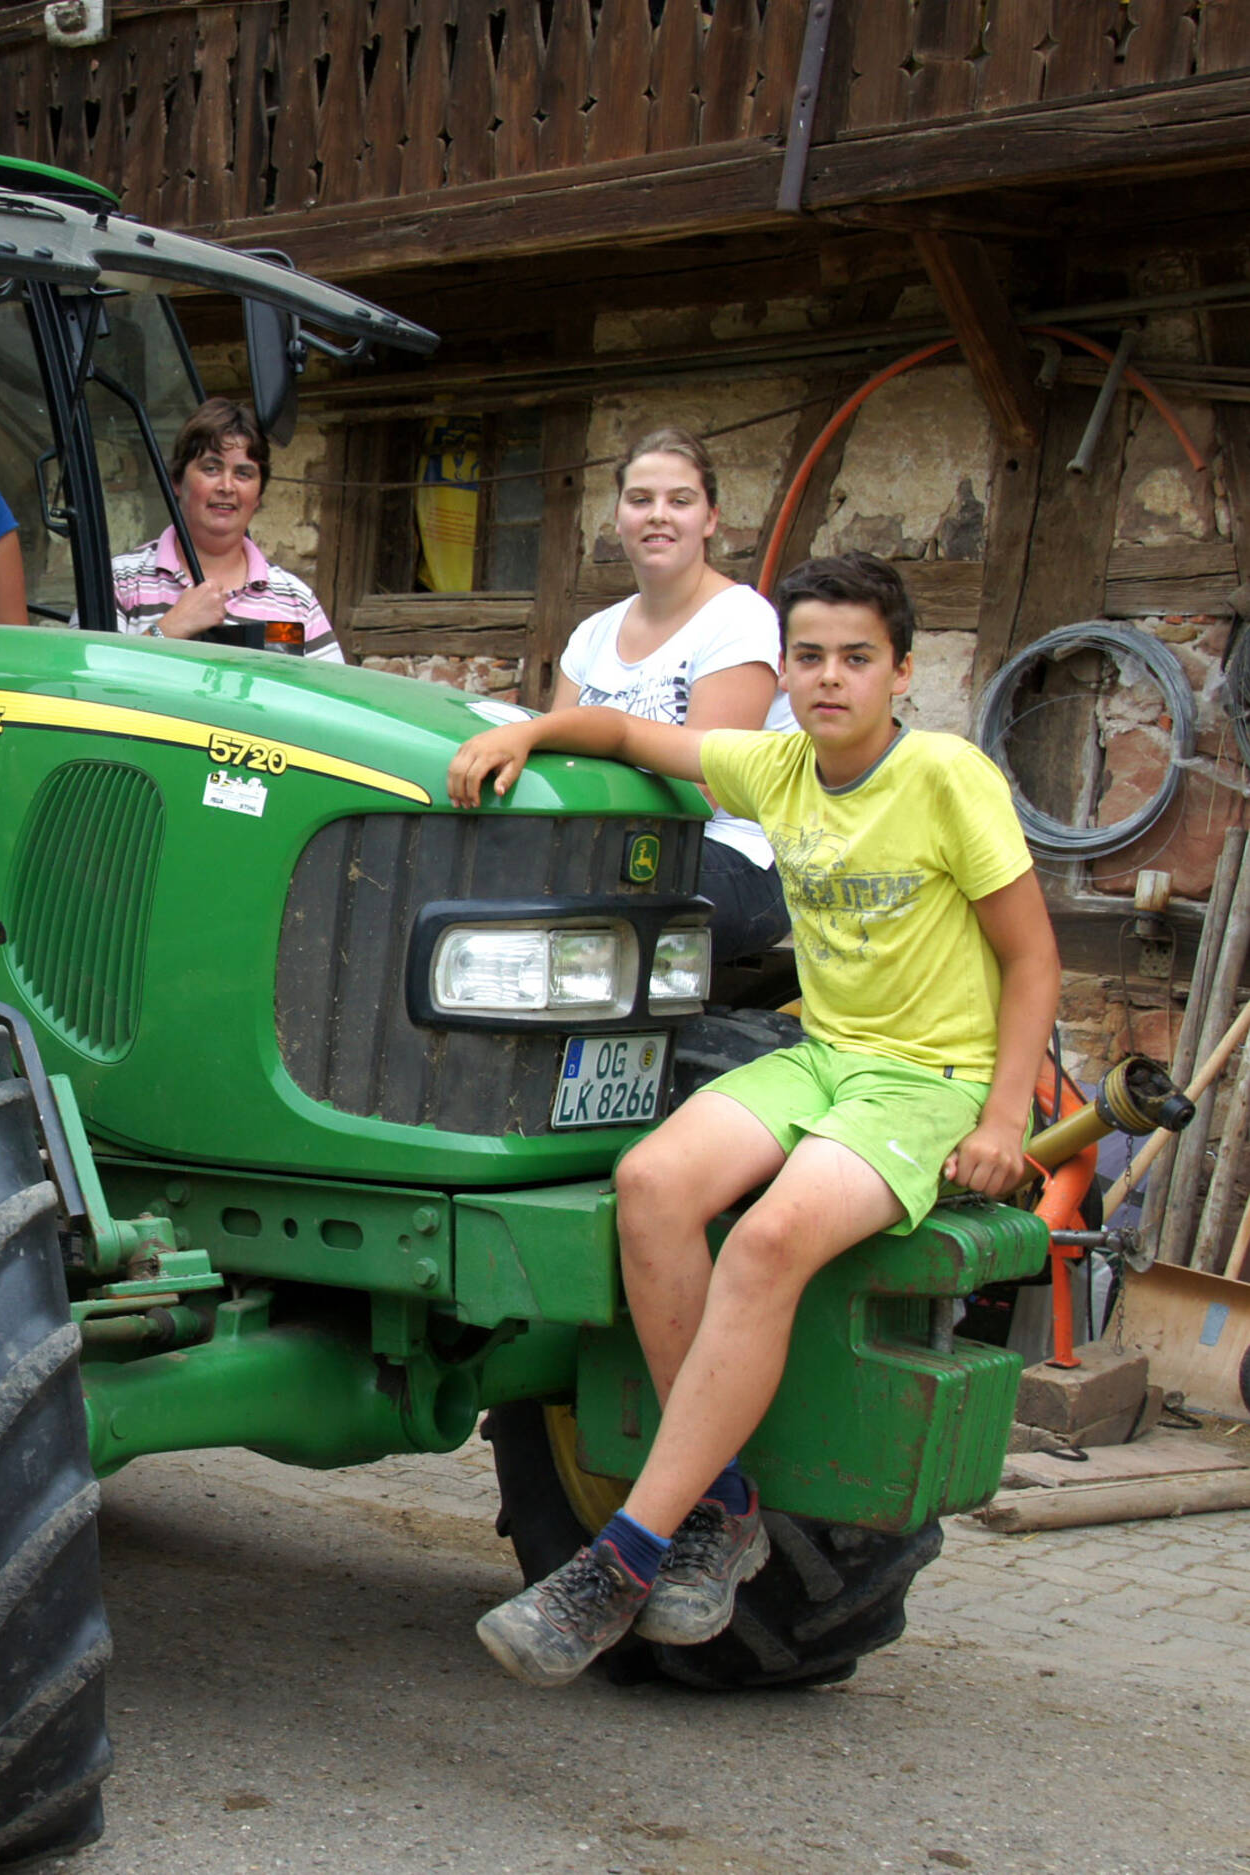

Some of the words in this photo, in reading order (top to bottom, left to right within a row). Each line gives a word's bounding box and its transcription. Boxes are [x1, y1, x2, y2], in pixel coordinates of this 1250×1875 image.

[209, 733, 288, 776] 5720
[568, 1064, 576, 1076] D
[596, 1041, 628, 1079] OG
[559, 1084, 594, 1121] LK
[597, 1080, 656, 1119] 8266
